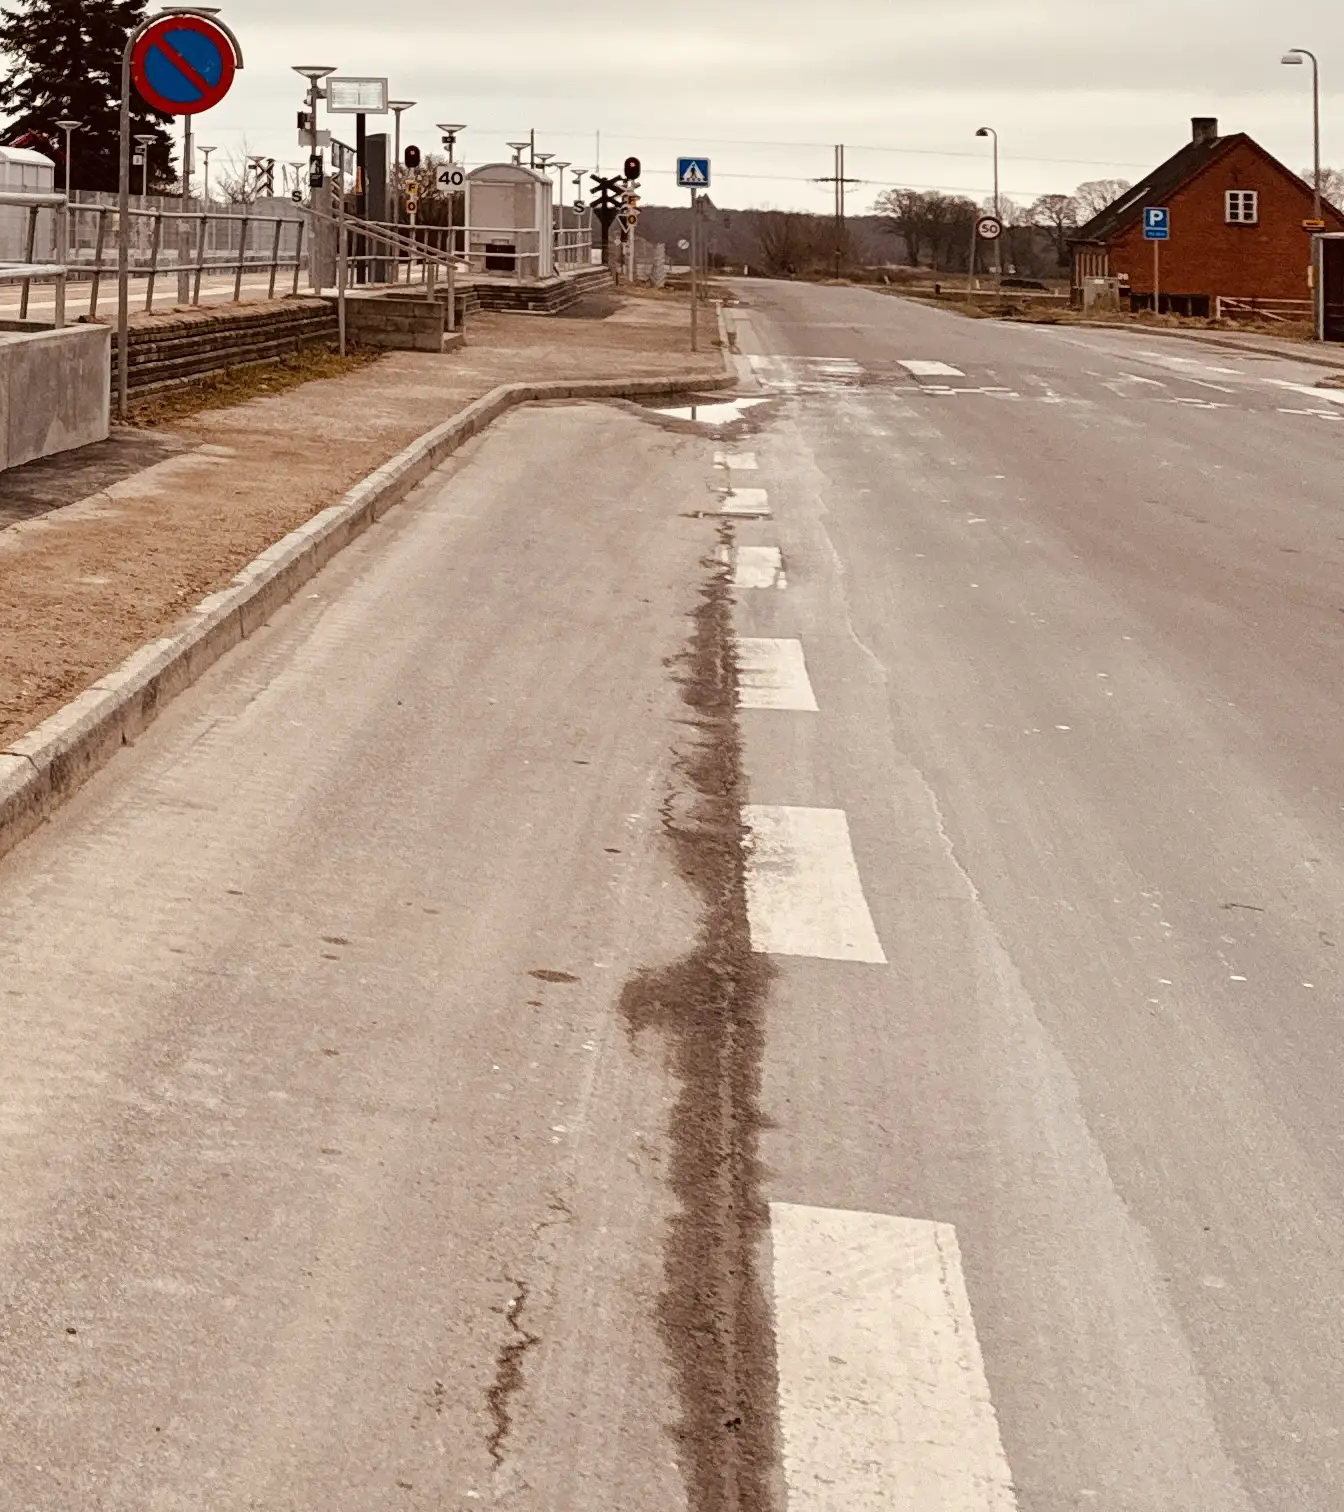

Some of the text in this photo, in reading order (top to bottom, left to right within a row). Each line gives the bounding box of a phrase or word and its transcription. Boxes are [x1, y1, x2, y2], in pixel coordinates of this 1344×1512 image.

[438, 171, 463, 185] 40
[292, 190, 302, 202] S
[573, 201, 584, 213] S
[1149, 210, 1164, 226] P
[982, 224, 998, 234] 50
